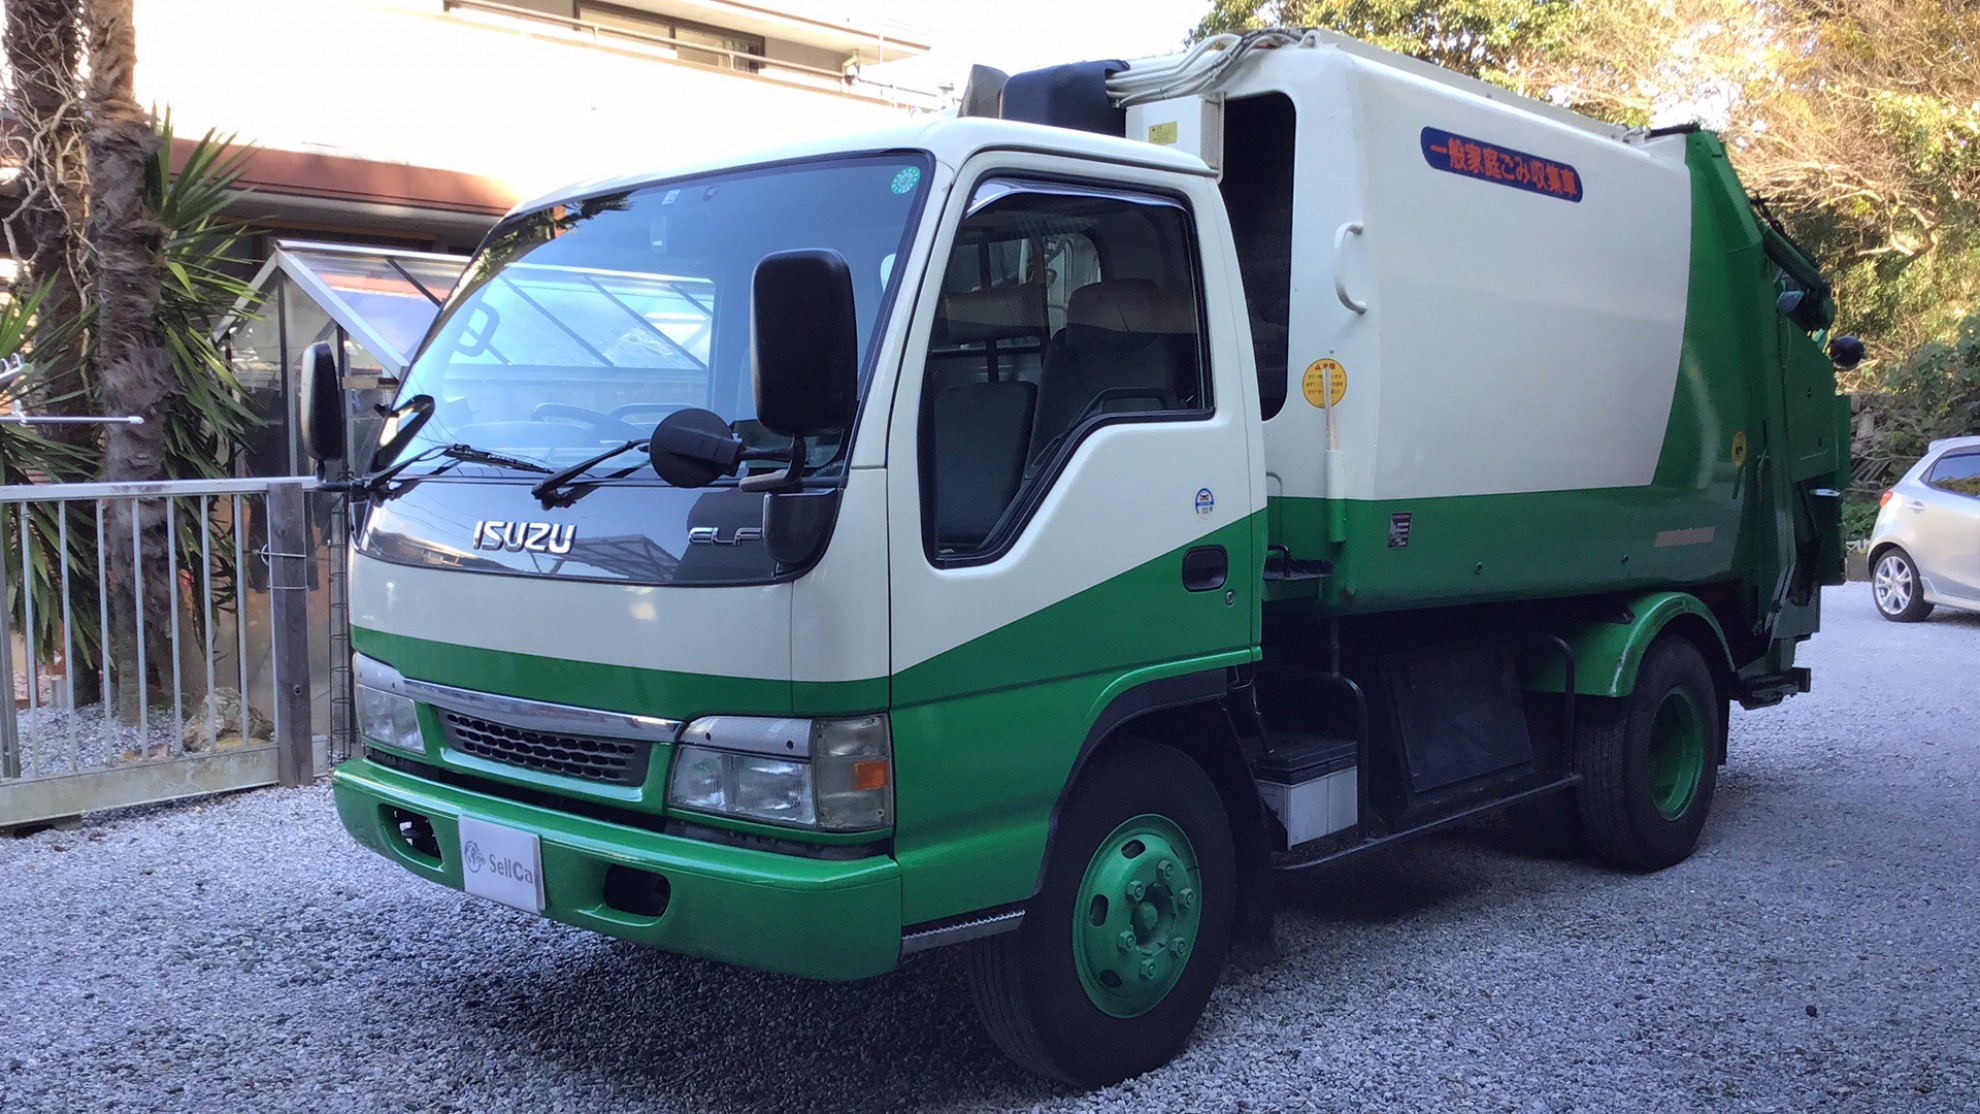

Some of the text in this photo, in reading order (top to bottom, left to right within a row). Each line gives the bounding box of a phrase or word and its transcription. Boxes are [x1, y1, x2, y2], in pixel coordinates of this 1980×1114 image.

[1430, 138, 1577, 196] 一般家庭ごみ収集車
[473, 520, 577, 555] ISUZU
